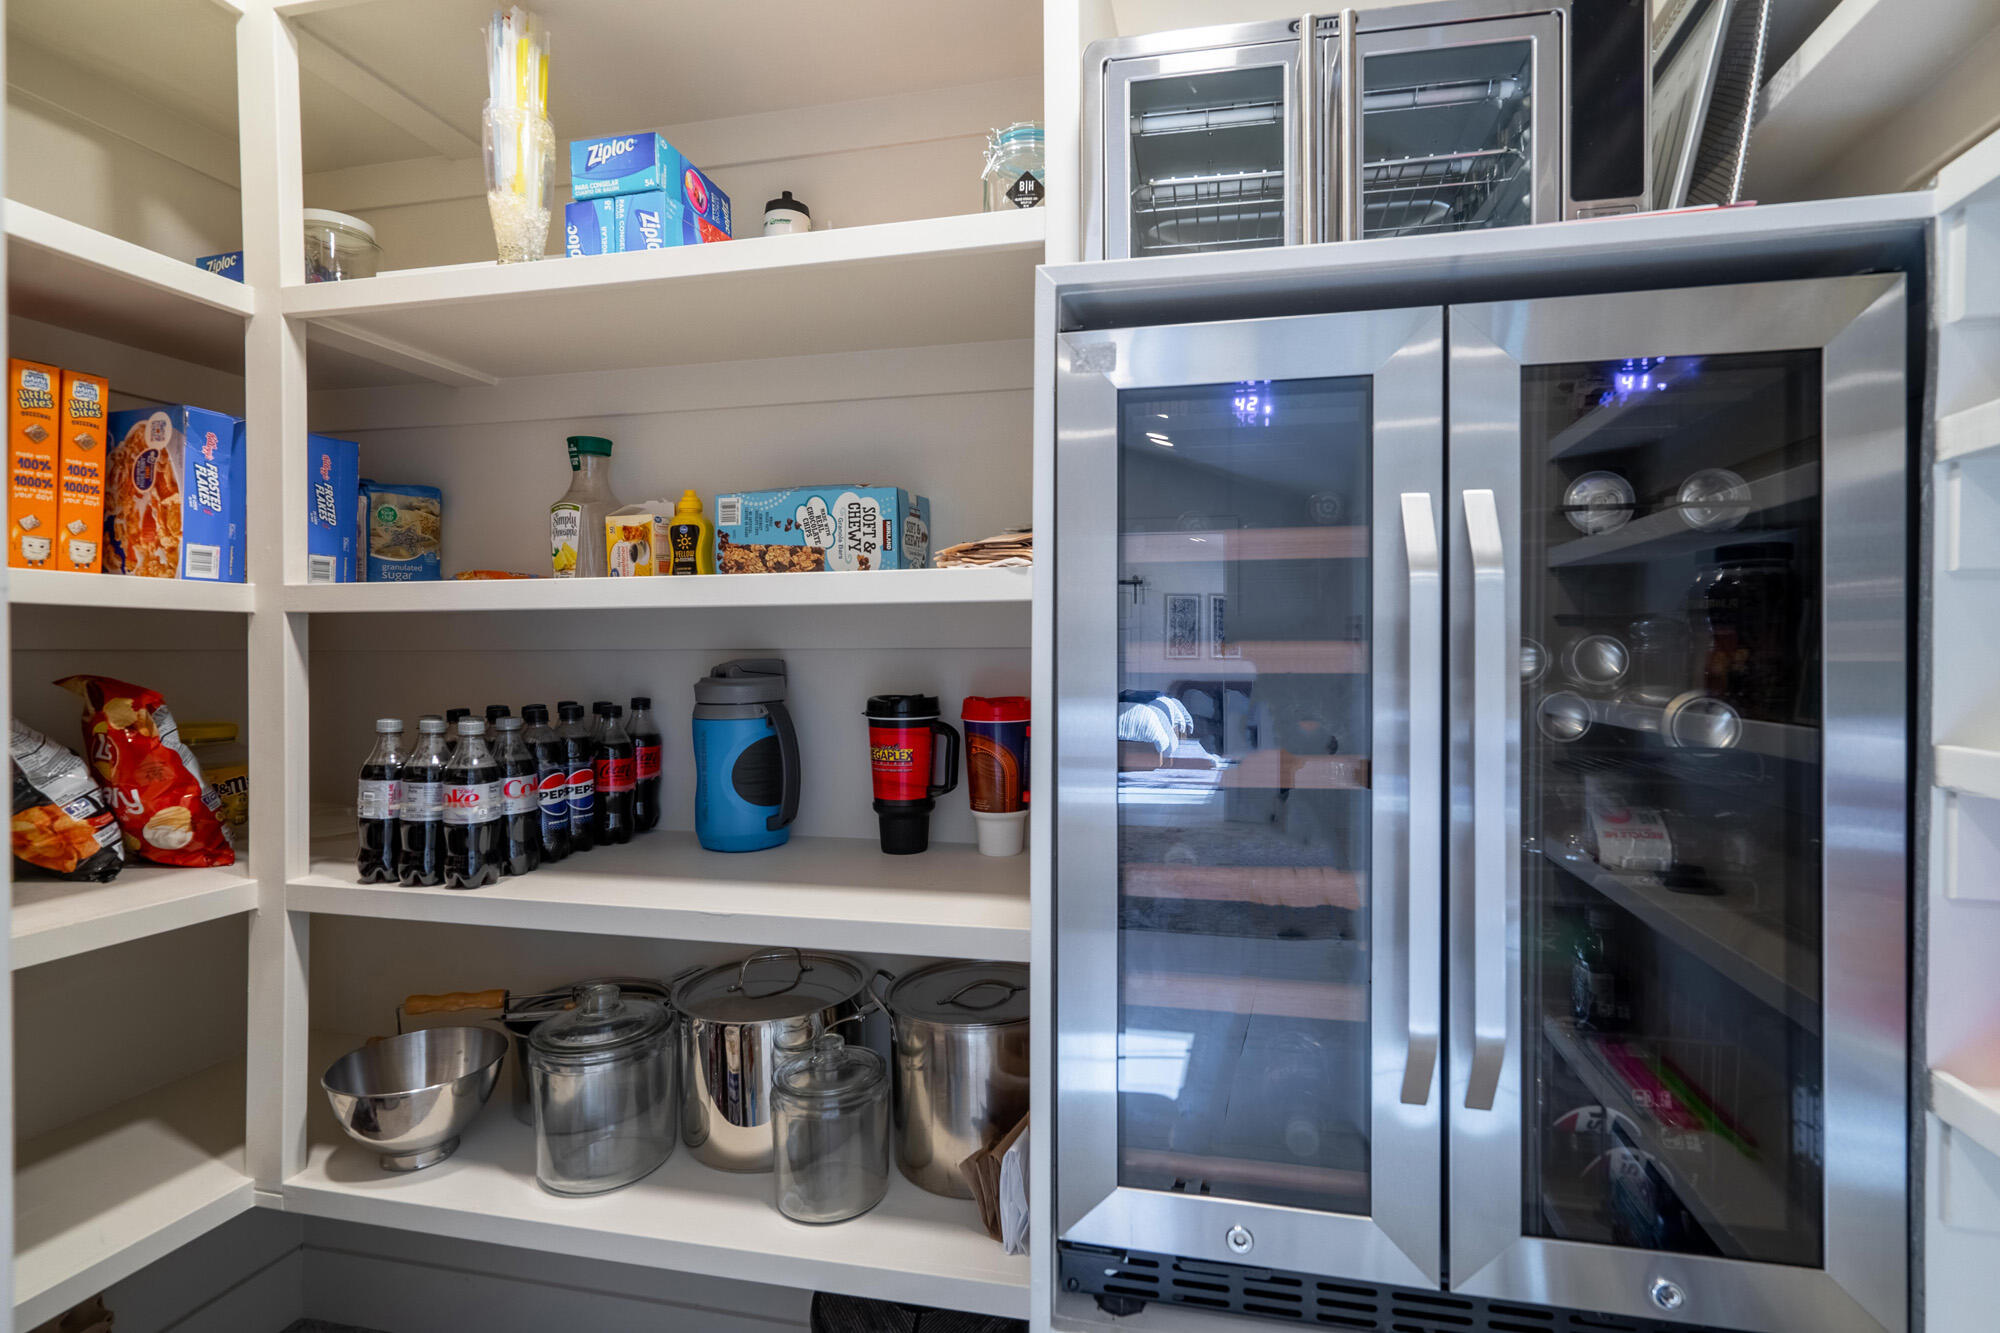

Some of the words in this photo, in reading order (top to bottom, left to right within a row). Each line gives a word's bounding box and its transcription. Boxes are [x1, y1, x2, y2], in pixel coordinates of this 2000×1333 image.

[587, 138, 635, 167] Ziploc
[639, 211, 663, 250] Ziplo
[206, 254, 237, 273] Ziploc
[1621, 374, 1649, 389] 41
[18, 390, 52, 401] little
[19, 399, 55, 409] bites
[69, 400, 101, 410] little
[1234, 396, 1259, 411] 42
[70, 408, 103, 418] bites
[17, 457, 52, 471] 100%
[67, 464, 99, 477] 100%
[14, 475, 53, 488] 1000%
[64, 481, 100, 495] 1000%
[194, 463, 211, 507] FLAKES
[205, 462, 222, 512] FROSTED
[314, 483, 328, 521] FLAKES
[323, 482, 337, 527] FROSTED
[552, 512, 578, 529] Simply
[802, 518, 813, 538] CHIPS
[806, 506, 821, 546] CHOCOLATE
[815, 514, 825, 533] REAL
[847, 502, 862, 553] CHEWY
[862, 506, 877, 538] SOFT
[863, 541, 877, 555] &
[381, 564, 423, 572] granulated
[381, 571, 413, 581] sugar
[872, 750, 914, 761] EGAPLEX
